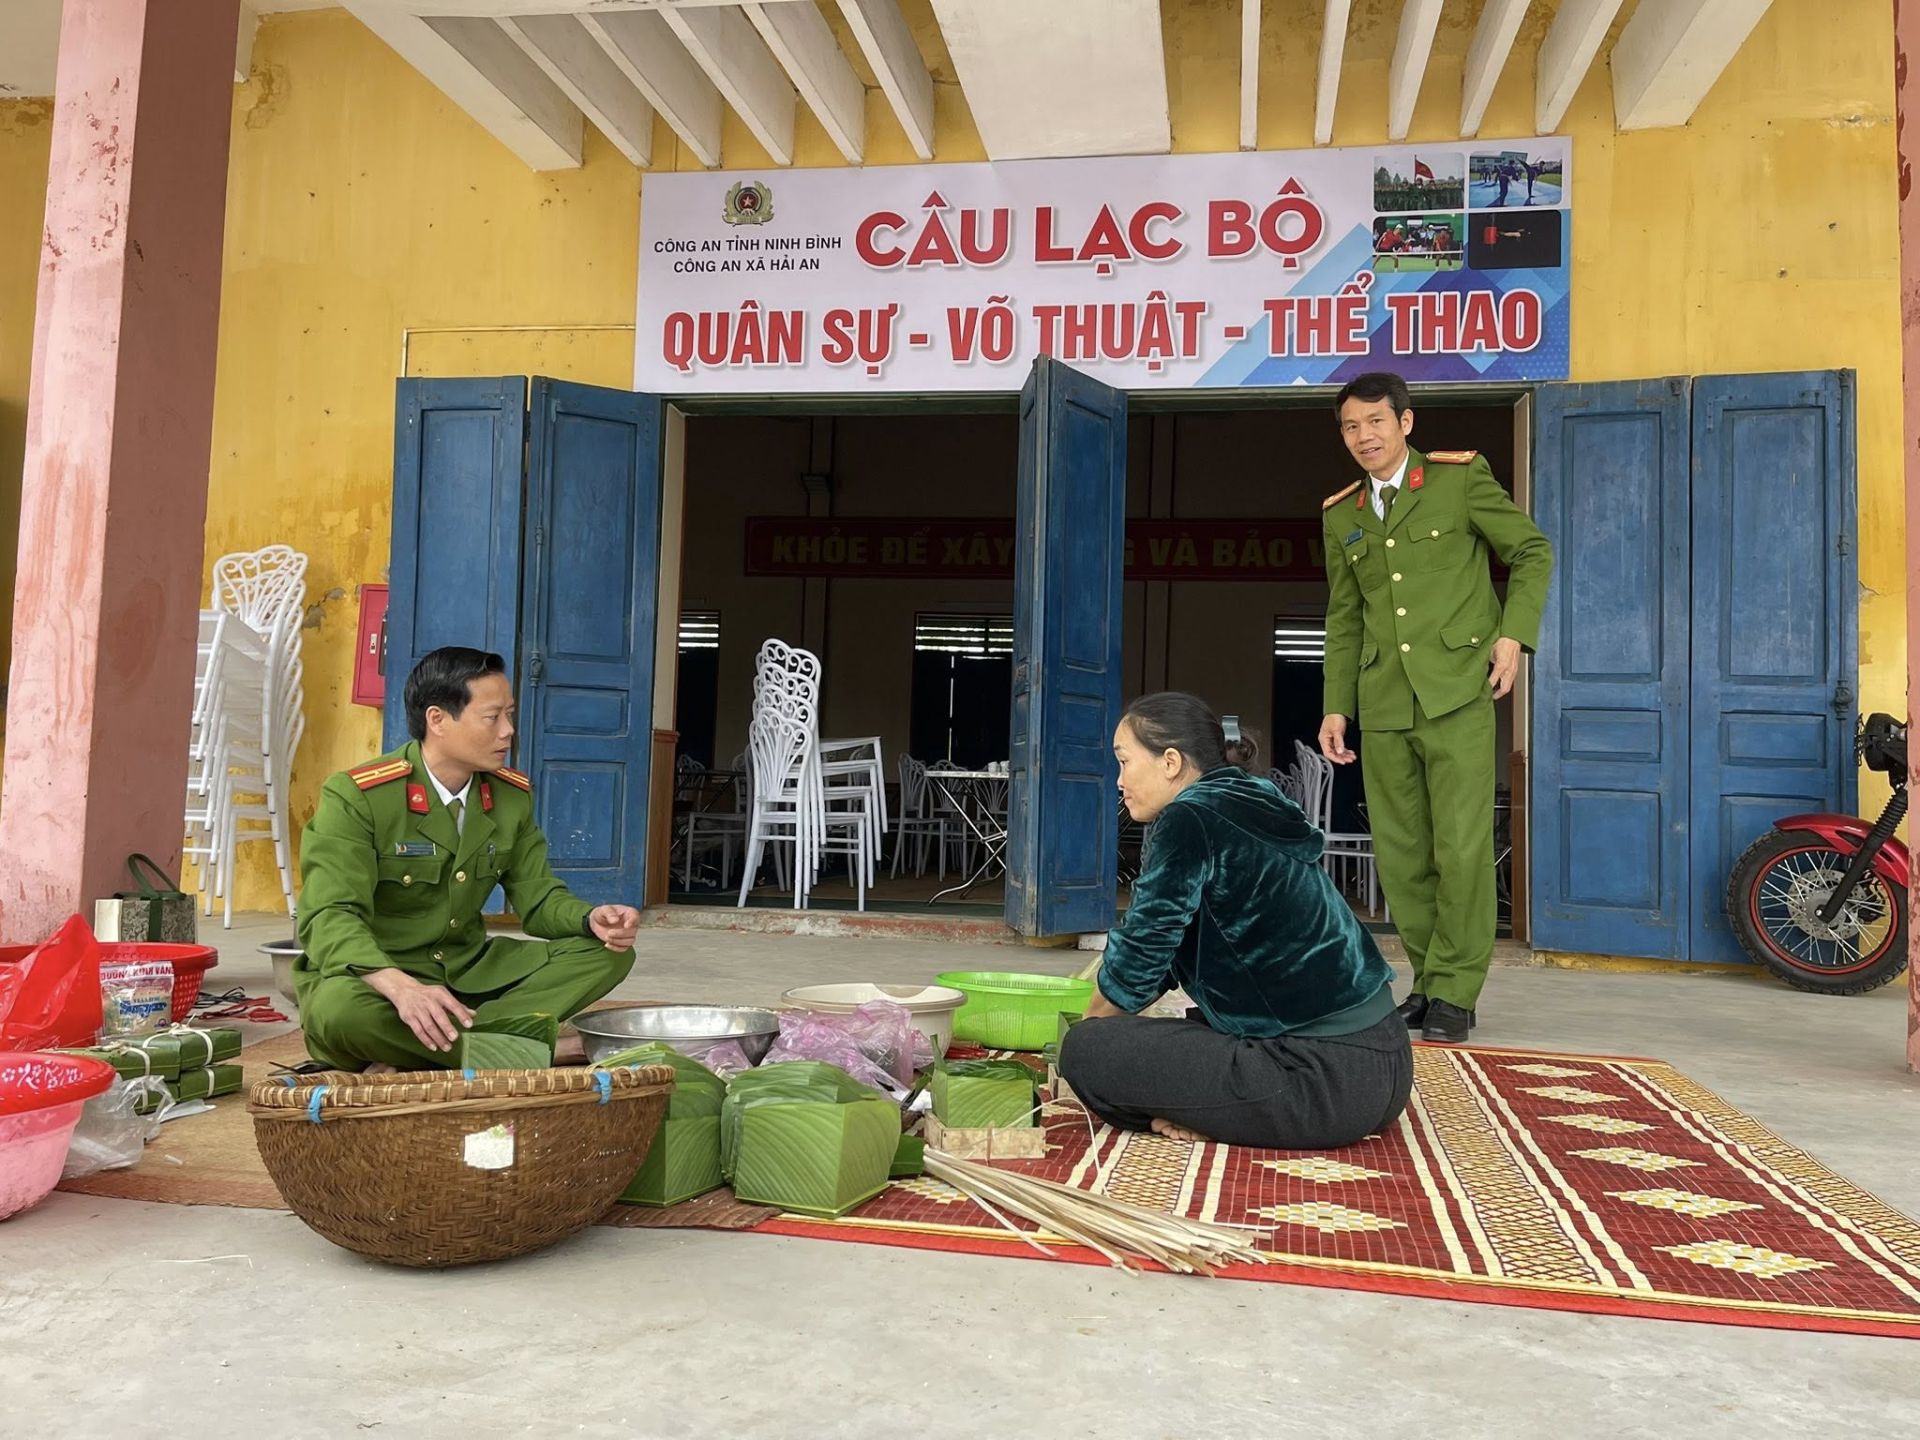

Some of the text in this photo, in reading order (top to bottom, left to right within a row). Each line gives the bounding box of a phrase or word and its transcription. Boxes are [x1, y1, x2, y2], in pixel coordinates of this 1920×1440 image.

[654, 235, 841, 252] CÔNG AN TỈNH NINH BÌNH
[856, 177, 1322, 273] CÂU LẠC BỘ
[673, 255, 819, 272] CÔNG AN XÃ HẢI AN
[664, 272, 1539, 373] QUÂN SỰ - VÕ THUẬT - THỂ THAO
[772, 526, 1014, 566] KHỎE ĐỂ XÂY
[1149, 531, 1200, 567] VÀ
[1212, 528, 1293, 567] BẢO
